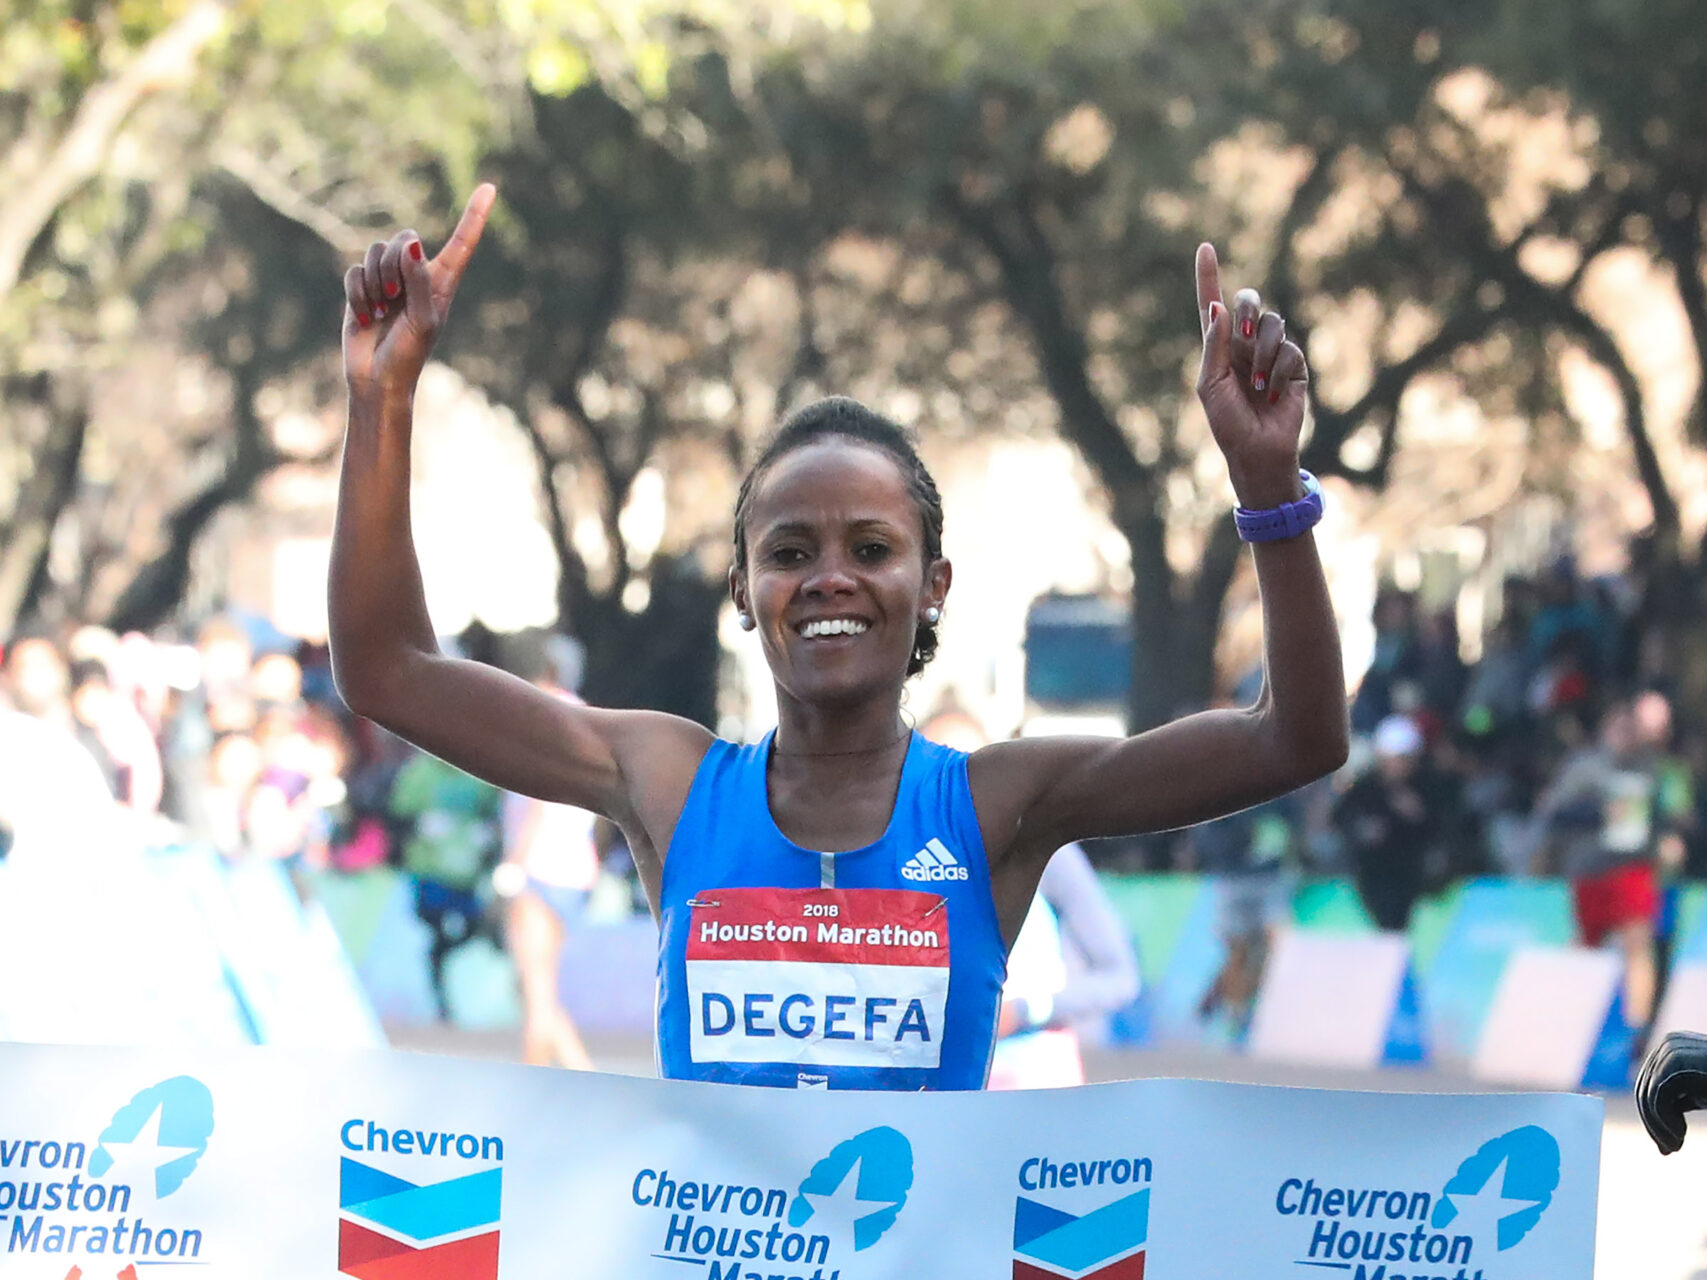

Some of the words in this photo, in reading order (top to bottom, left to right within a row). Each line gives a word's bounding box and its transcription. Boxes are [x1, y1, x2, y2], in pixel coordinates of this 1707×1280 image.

[901, 865, 968, 881] adidas
[803, 904, 839, 917] 2018
[700, 921, 808, 944] Houston
[816, 923, 939, 948] Marathon
[701, 992, 931, 1042] DEGEFA
[340, 1119, 504, 1161] Chevron
[632, 1169, 788, 1218] Chevron
[1018, 1157, 1153, 1192] Chevron
[1275, 1178, 1431, 1220] Chevron
[8, 1215, 203, 1257] Marathon
[663, 1214, 830, 1264] Houston
[1308, 1221, 1473, 1265] Houston
